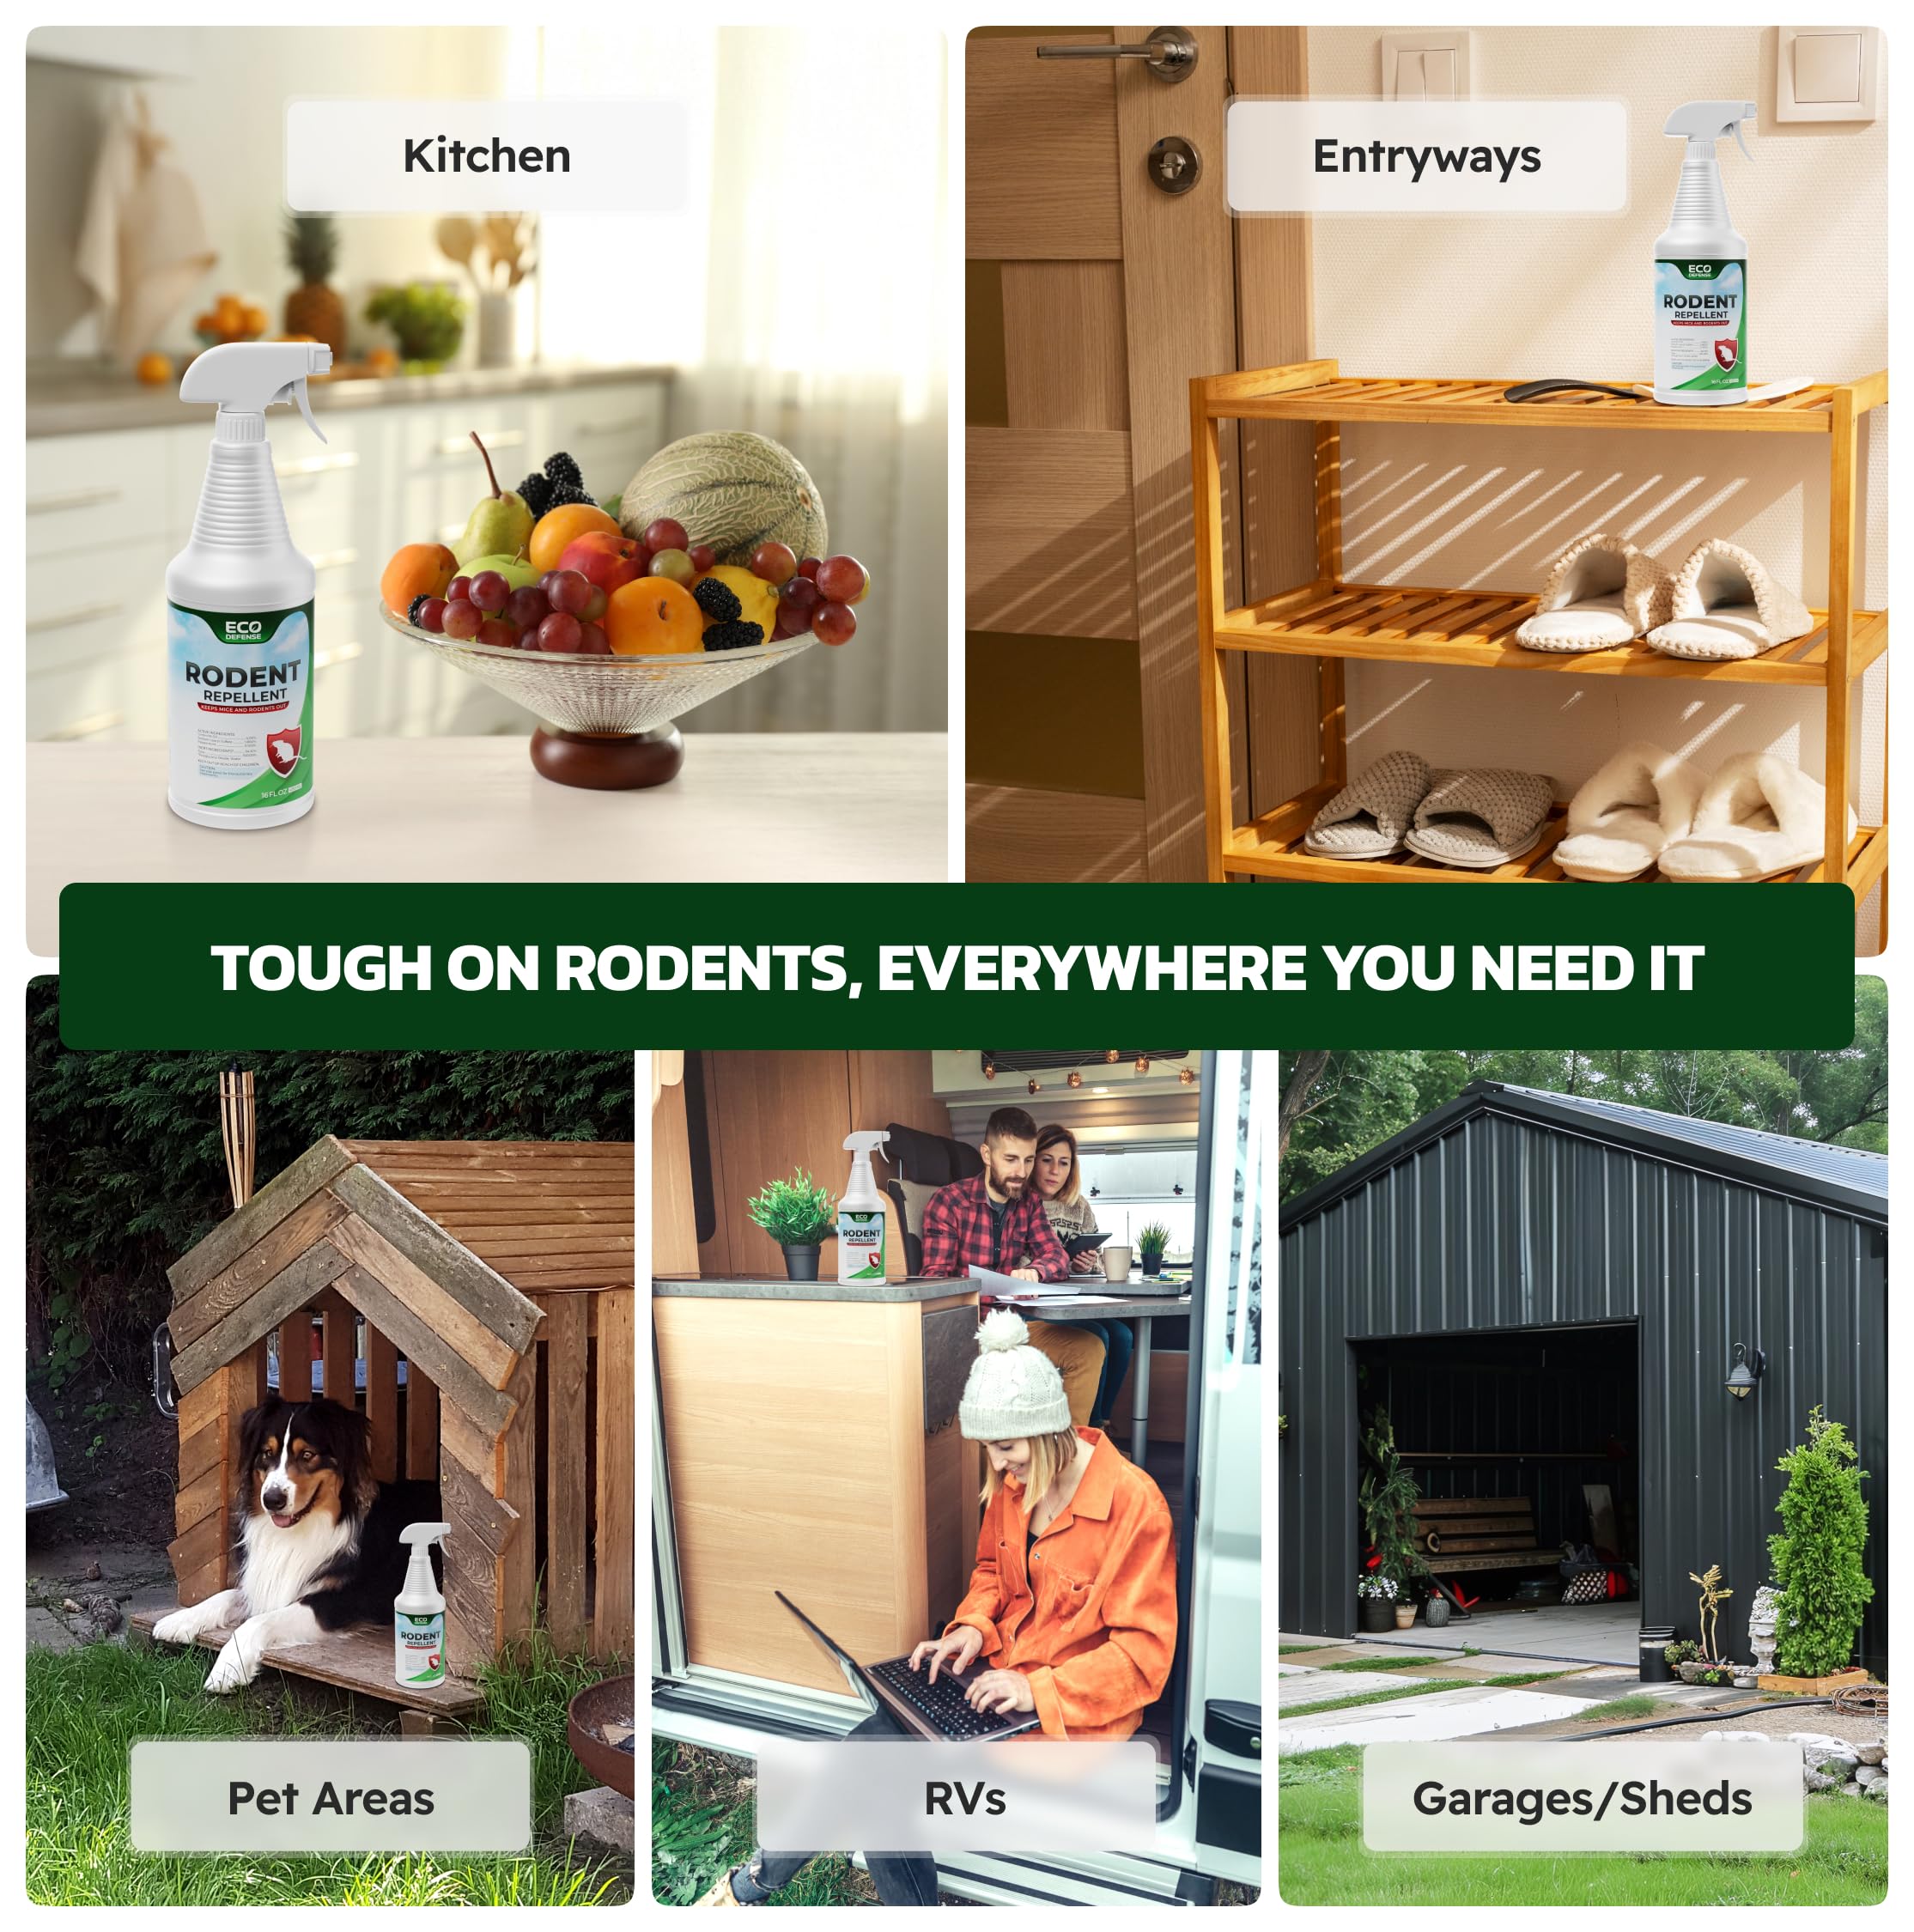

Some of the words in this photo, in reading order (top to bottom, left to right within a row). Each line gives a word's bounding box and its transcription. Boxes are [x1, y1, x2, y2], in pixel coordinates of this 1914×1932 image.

[1688, 264, 1712, 273] ECO
[1664, 294, 1737, 309] RODENT
[1674, 311, 1729, 319] REPELLENT
[225, 622, 262, 634] ECO
[185, 659, 301, 688] RODENT
[204, 688, 288, 703] REPELLENT
[401, 1631, 441, 1641] RODENT
